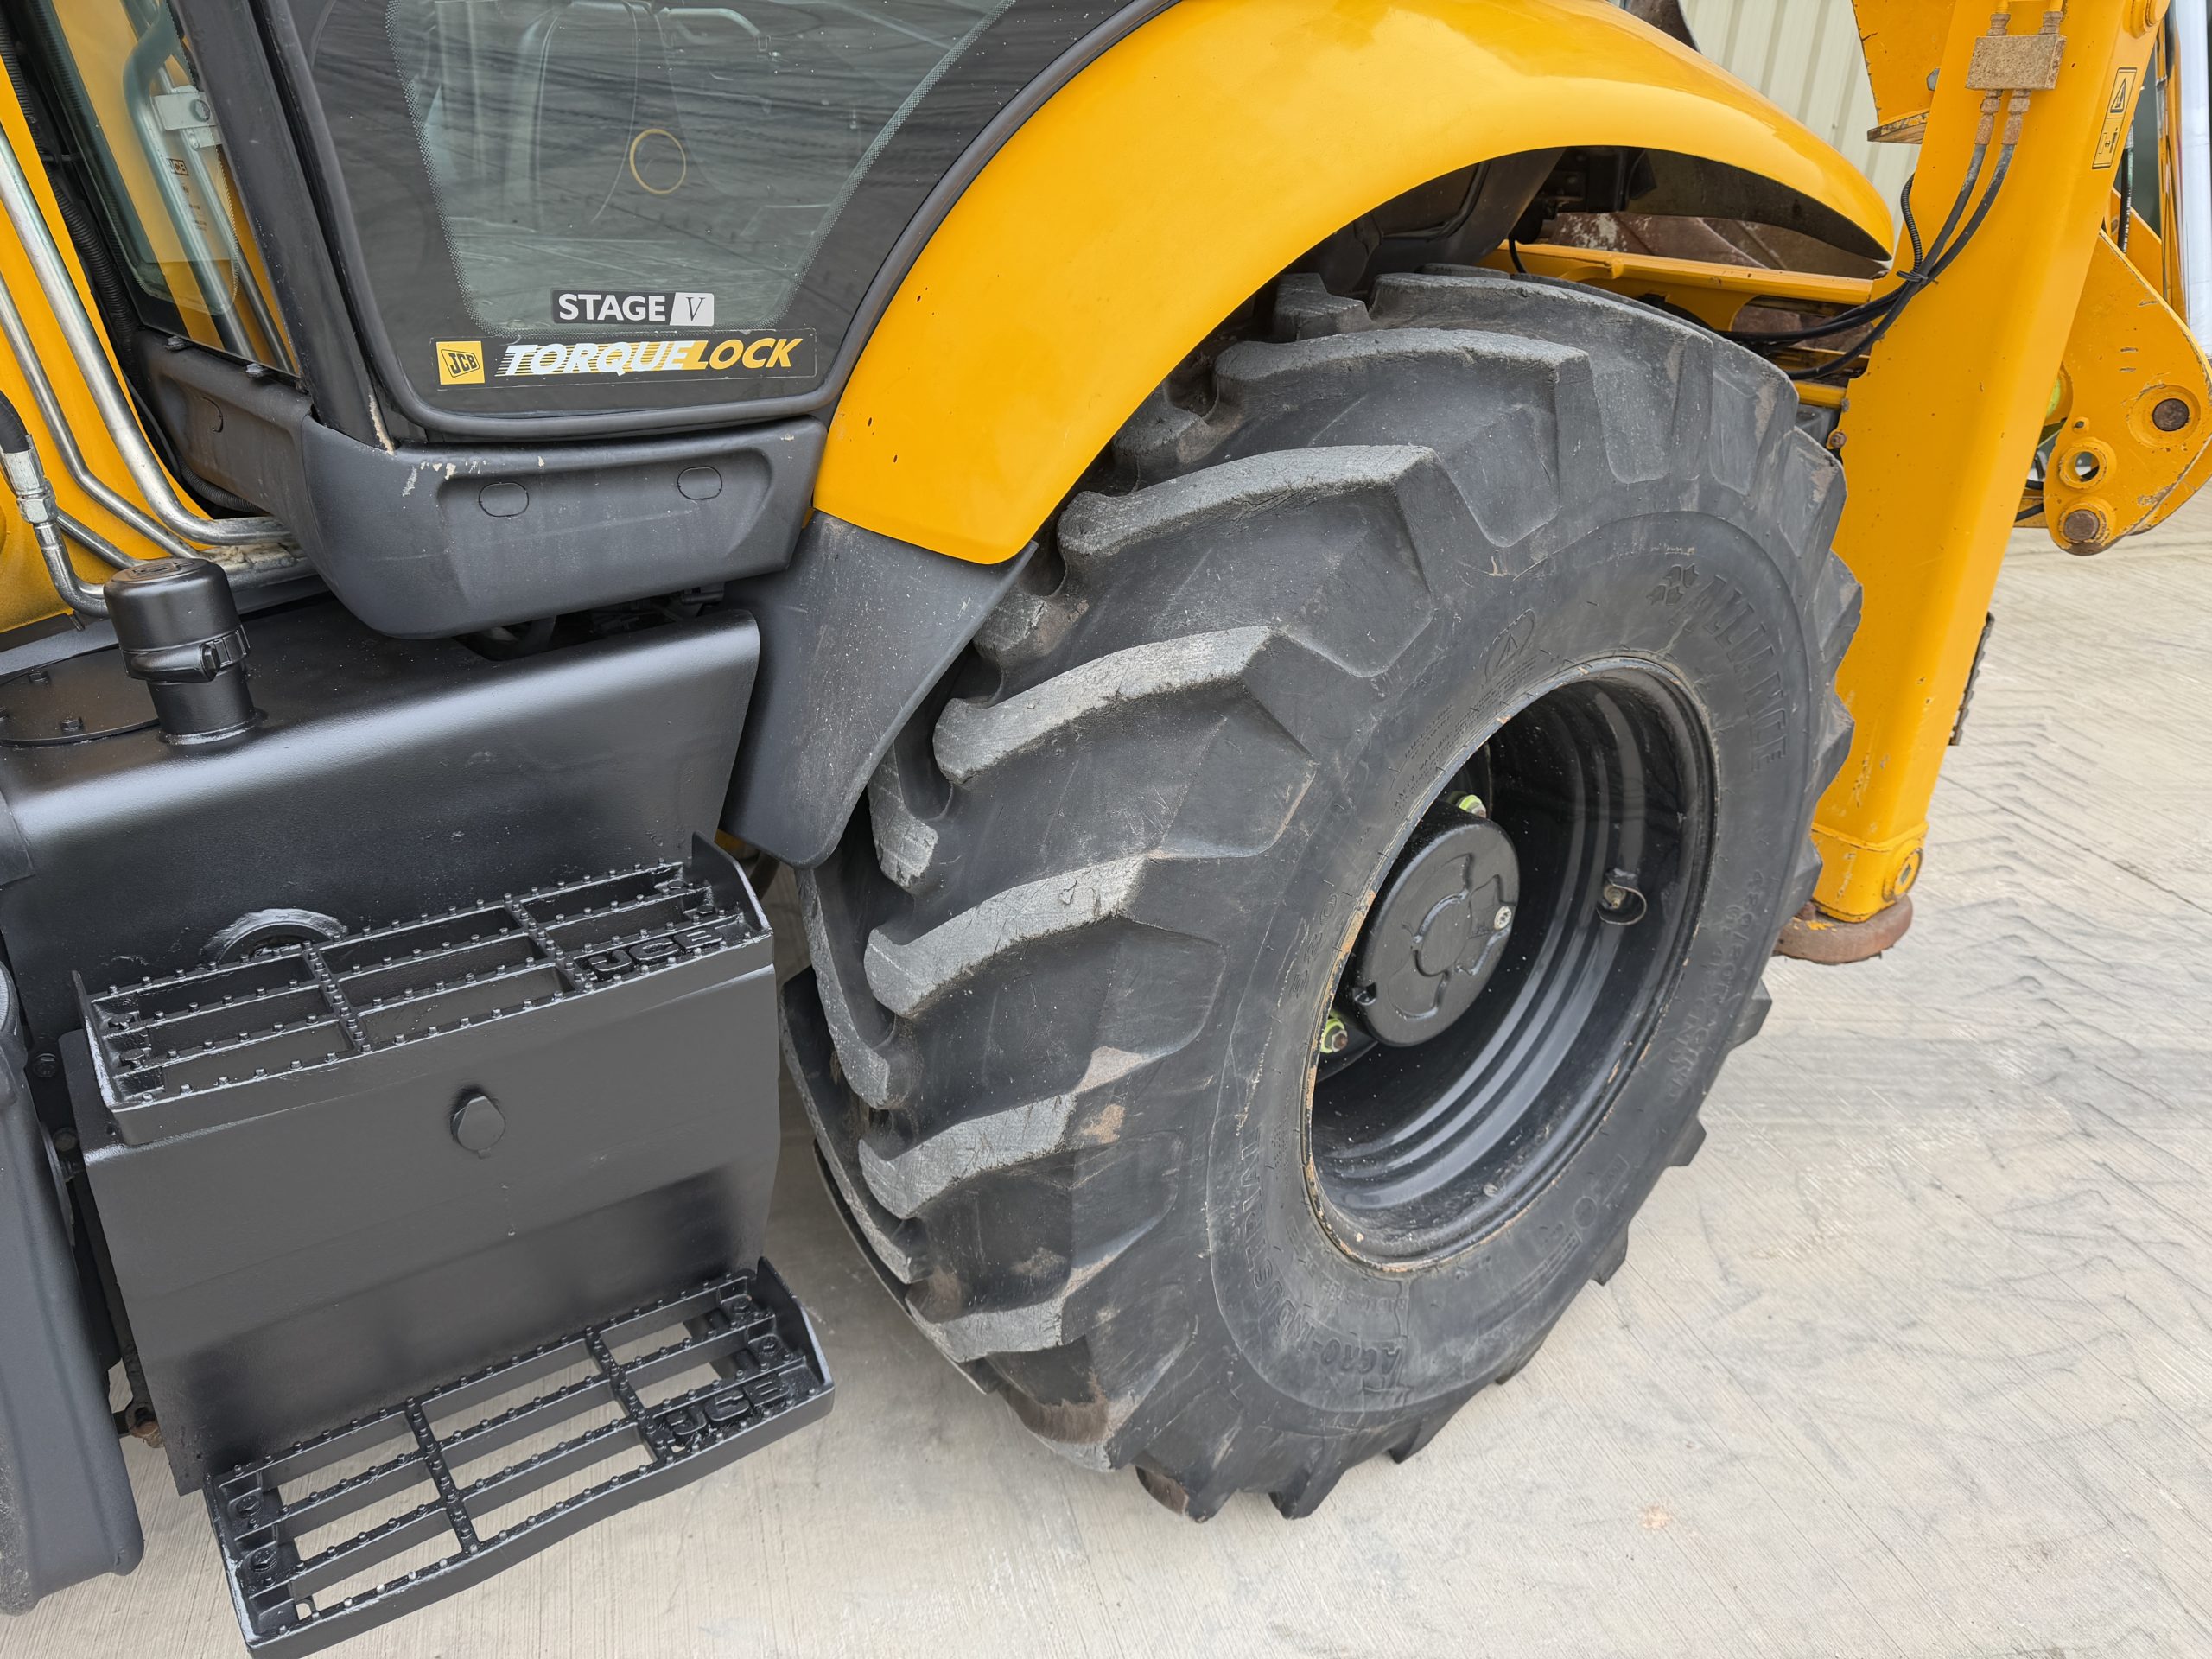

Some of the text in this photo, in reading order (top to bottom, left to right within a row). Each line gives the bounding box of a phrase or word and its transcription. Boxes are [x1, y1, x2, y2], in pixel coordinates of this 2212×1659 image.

[557, 294, 706, 322] STAGE V
[448, 351, 479, 375] JCB
[495, 337, 804, 377] TORQUELOCK
[1668, 574, 1788, 772] ALLIANCE
[1239, 1124, 1402, 1375] AGRO-INDUSTRIAL
